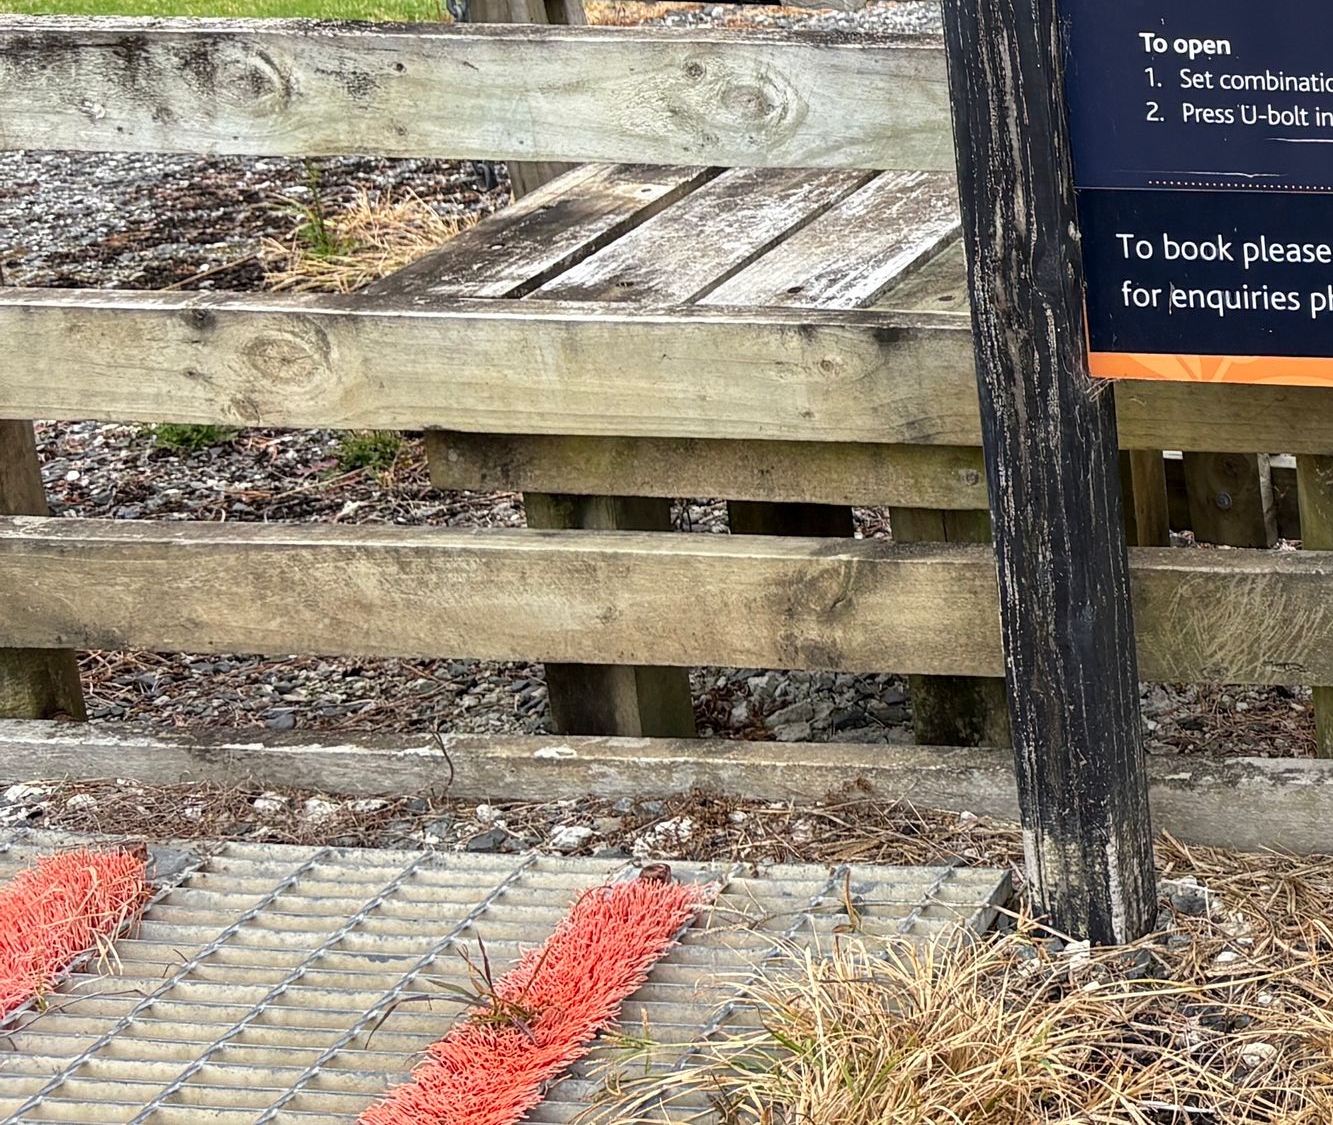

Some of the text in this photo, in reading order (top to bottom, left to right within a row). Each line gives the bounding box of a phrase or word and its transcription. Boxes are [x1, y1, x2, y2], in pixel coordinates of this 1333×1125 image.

[1139, 32, 1231, 60] To open
[1144, 68, 1162, 88] 1.
[1180, 68, 1213, 89] Set
[1146, 102, 1164, 122] 2.
[1182, 103, 1234, 123] Press
[1240, 104, 1309, 126] U-bolt
[1315, 107, 1333, 127] in
[1116, 233, 1153, 260] To
[1164, 233, 1234, 262] book
[1243, 236, 1331, 269] please
[1122, 280, 1161, 307] for
[1172, 283, 1300, 317] enquiries
